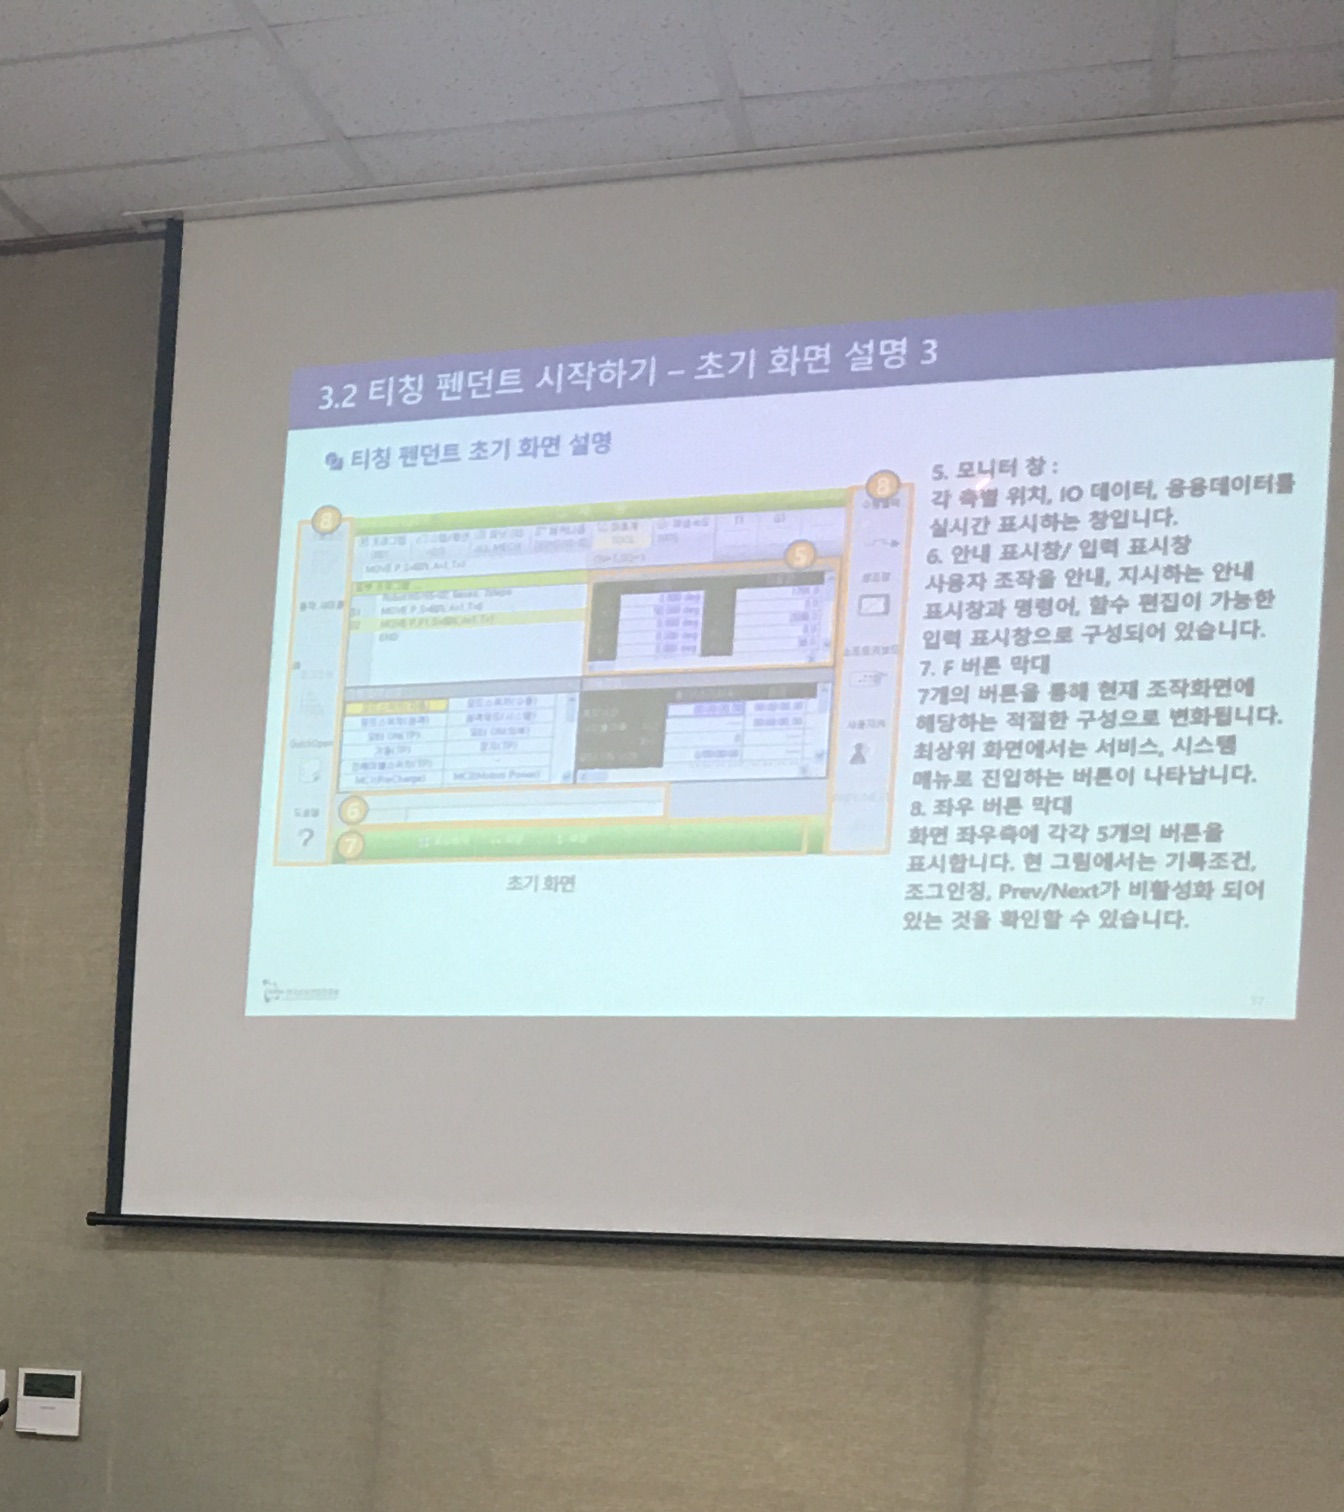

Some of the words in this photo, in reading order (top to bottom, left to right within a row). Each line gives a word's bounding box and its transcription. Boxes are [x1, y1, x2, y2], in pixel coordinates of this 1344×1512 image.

[317, 383, 357, 411] 3.2
[369, 374, 424, 408] 티칭
[436, 366, 525, 404] 펜던트
[535, 356, 658, 396] 시작하기
[693, 344, 757, 382] 초기
[768, 340, 833, 377] 화면
[845, 336, 908, 373] 설명
[920, 339, 940, 365] 3
[351, 449, 391, 472] 티칭
[398, 443, 461, 470] 펜던트
[469, 438, 512, 464] 초기
[518, 434, 562, 459] 화면
[570, 431, 612, 457] 설명
[932, 463, 948, 481] 5.
[956, 458, 1017, 479] 모니터
[1025, 456, 1046, 477] 창
[931, 489, 952, 510] 각
[1006, 485, 1052, 506] 위치,
[1060, 485, 1083, 502] IO
[1091, 479, 1158, 502] 데이터,
[930, 515, 991, 538] 실시간
[997, 511, 1080, 534] 표시하는
[1089, 506, 1178, 531] 창입니다.
[926, 548, 942, 564] 6.
[952, 542, 991, 563] 안내
[999, 539, 1072, 562] 표시창/
[1079, 537, 1119, 559] 입력
[1127, 534, 1192, 556] 표시창
[925, 571, 987, 594] 사용자
[994, 568, 1056, 590] 조작을
[1065, 565, 1111, 588] 안내,
[1118, 562, 1204, 585] 지시하는
[1212, 560, 1255, 582] 안내
[923, 599, 1005, 621] 표시창과
[1014, 596, 1080, 618] 명령어,
[1089, 594, 1129, 616] 함수
[1139, 591, 1202, 614] 편집이
[1210, 588, 1275, 611] 가능한
[923, 628, 961, 650] 입력
[970, 625, 1073, 648] 표시창으로
[1082, 622, 1166, 644] 구성되어
[1174, 619, 1266, 641] 있습니다.
[920, 660, 936, 676] 7.
[943, 659, 954, 676] F
[961, 655, 1001, 676] 버튼
[1010, 654, 1051, 676] 막대
[918, 685, 970, 706] 7개의
[978, 682, 1040, 704] 버튼을
[1097, 679, 1139, 701] 현재
[1146, 676, 1255, 699] 조작화면에
[916, 712, 998, 733] 해당하는
[1007, 709, 1069, 731] 적절한
[1076, 708, 1161, 729] 구성으로
[1169, 704, 1283, 728] 변화됩니다.
[913, 740, 976, 761] 최상위
[982, 738, 1088, 760] 화면에서는
[1095, 736, 1164, 759] 서비스,
[1172, 734, 1236, 756] 시스템
[912, 768, 973, 790] 메뉴로
[981, 767, 1064, 788] 진입하는
[1072, 766, 1135, 787] 버튼이
[1143, 763, 1258, 786] 나타납니다.
[910, 800, 926, 817] 8.
[933, 797, 974, 817] 좌우
[982, 796, 1023, 817] 버튼
[1032, 794, 1073, 816] 막대
[907, 825, 949, 846] 화면
[1048, 823, 1090, 844] 각각
[1096, 822, 1151, 843] 5개의
[1159, 821, 1225, 843] 버튼을
[906, 852, 1015, 874] 표시합니다.
[1023, 851, 1042, 873] 현
[1050, 851, 1157, 872] 그림에서는
[1165, 850, 1257, 872] 기록조건,
[506, 874, 539, 894] 초기
[542, 874, 576, 893] 화면
[999, 880, 1121, 902] Prev/Next가
[1128, 879, 1215, 901] 비활성화
[1221, 879, 1265, 901] 되어
[903, 910, 943, 931] 있는
[952, 909, 992, 931] 것을
[999, 908, 1063, 930] 확인할
[1070, 908, 1091, 930] 수
[1098, 908, 1190, 930] 있습니다.
